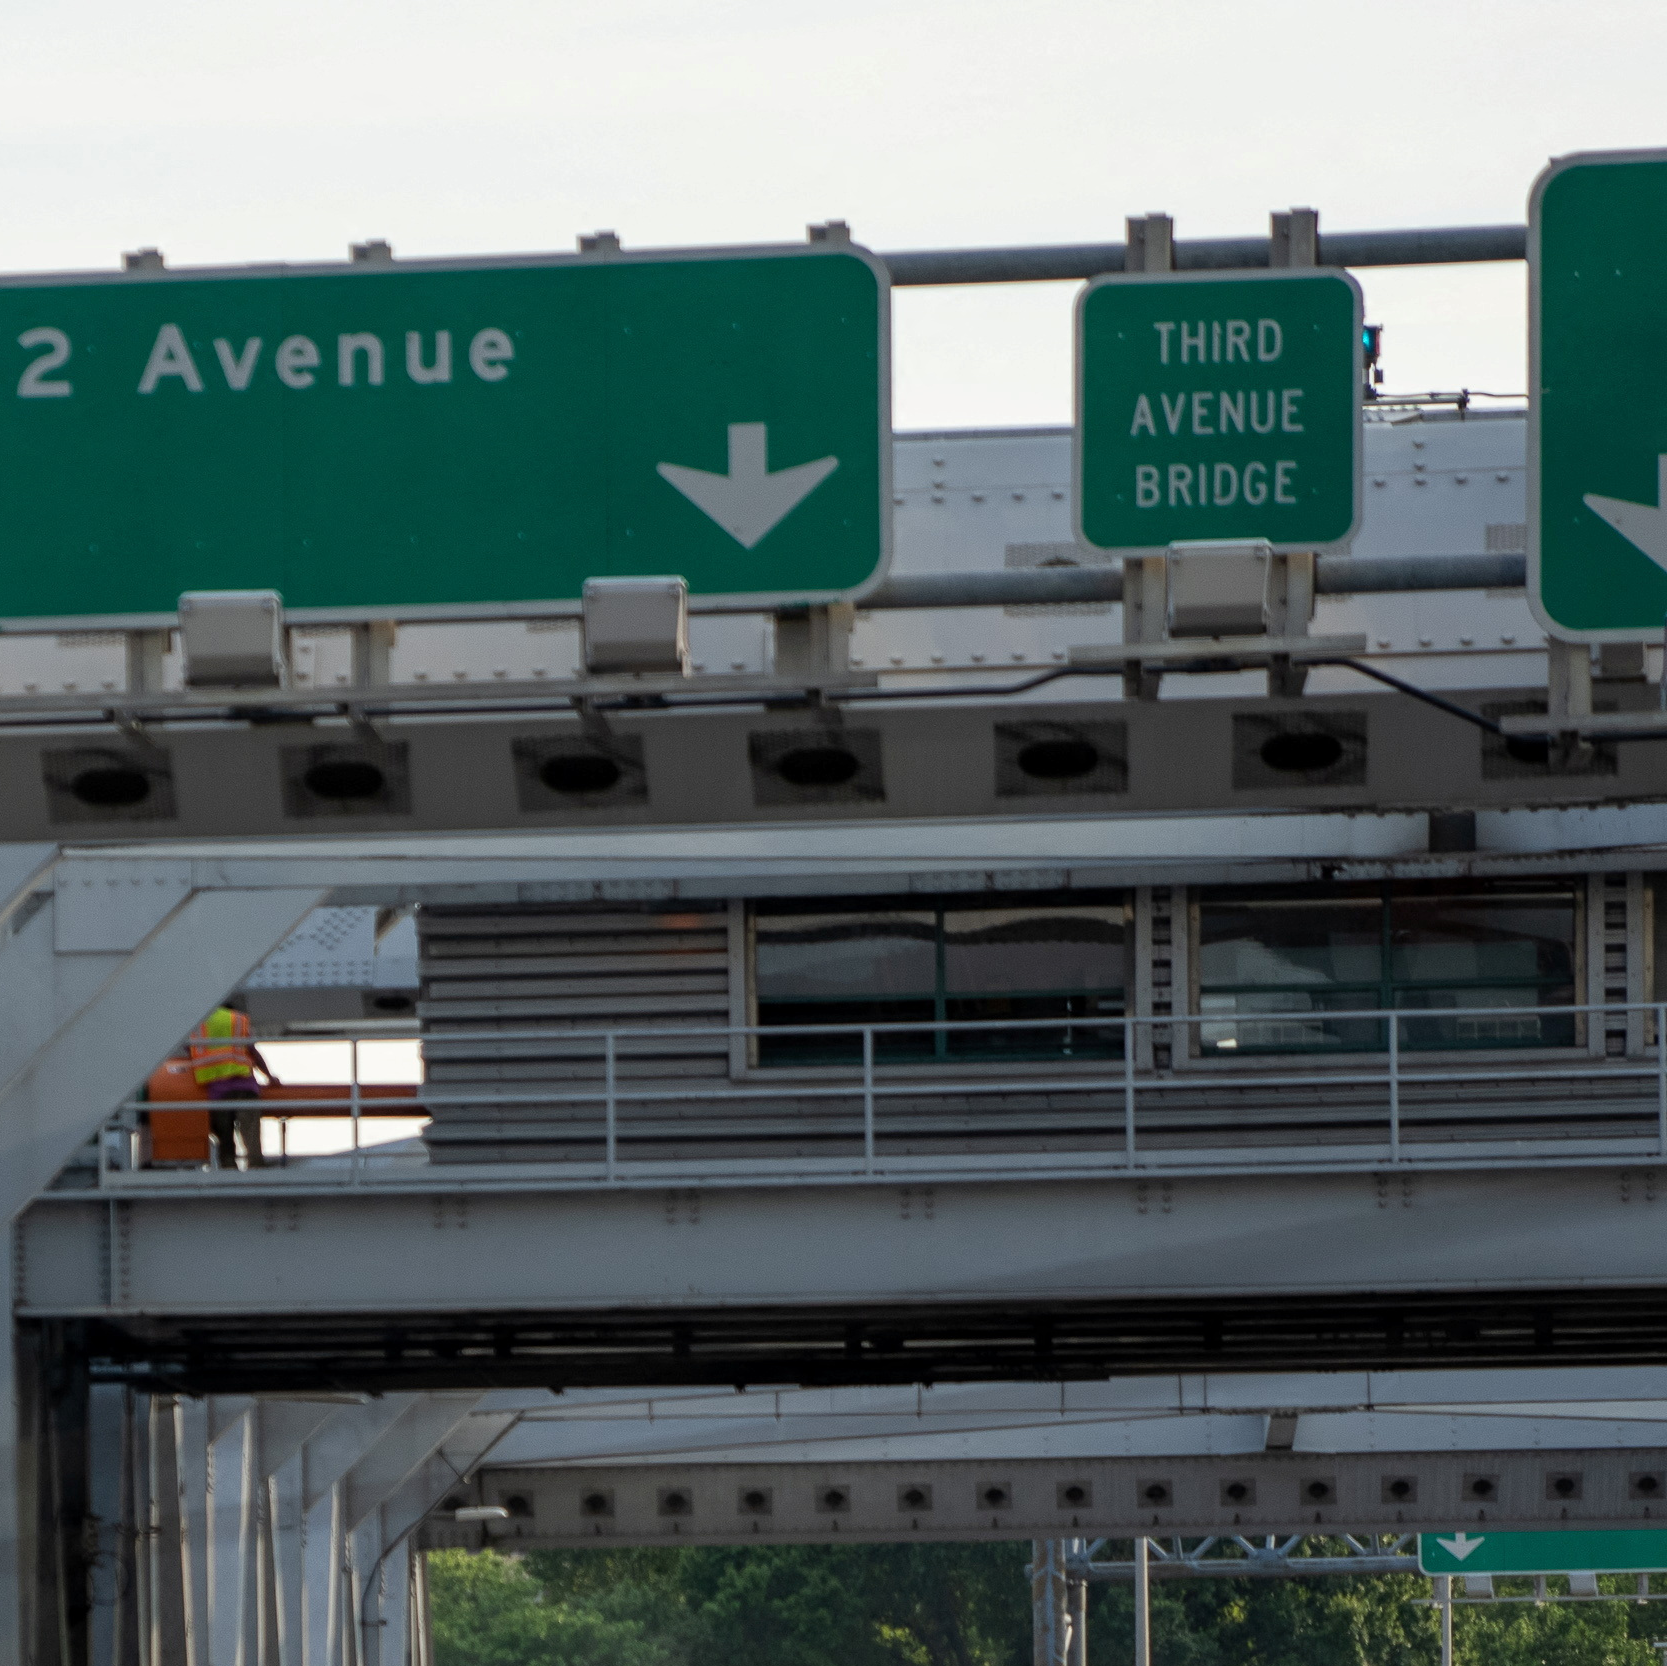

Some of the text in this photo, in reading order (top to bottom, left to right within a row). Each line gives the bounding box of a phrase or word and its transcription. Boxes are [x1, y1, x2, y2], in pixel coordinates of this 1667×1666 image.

[17, 323, 515, 397] 2 Avenue
[1153, 318, 1284, 365] THIRD
[1129, 388, 1305, 437] AVENUE
[1135, 460, 1298, 509] BRIDGE
